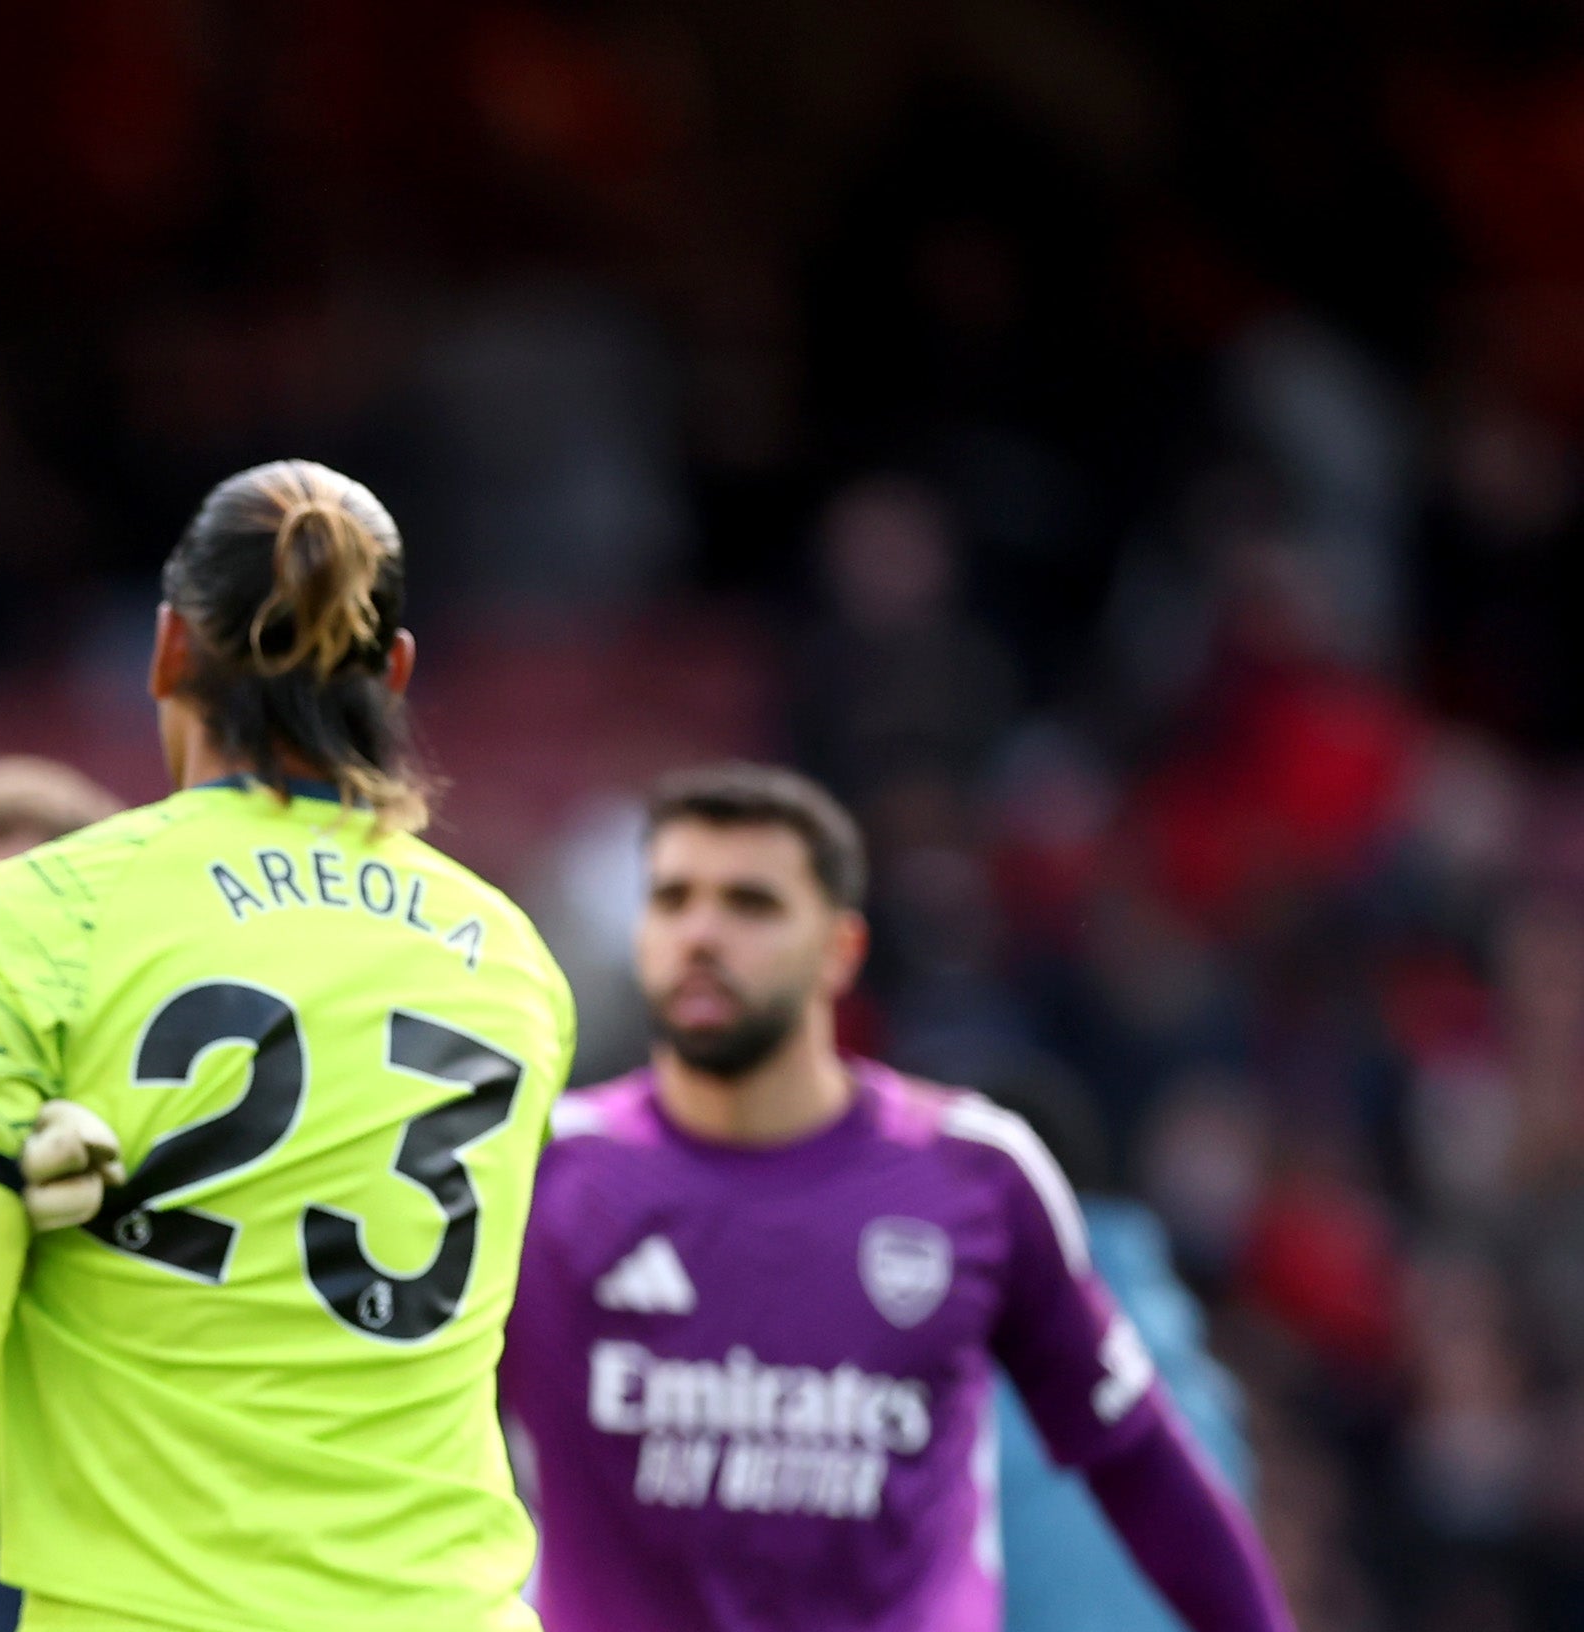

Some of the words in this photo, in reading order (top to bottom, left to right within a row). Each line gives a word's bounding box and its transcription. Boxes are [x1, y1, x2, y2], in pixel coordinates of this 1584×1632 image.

[211, 848, 483, 969] AREOLA
[83, 977, 526, 1346] 23
[588, 1338, 931, 1456] Emirates
